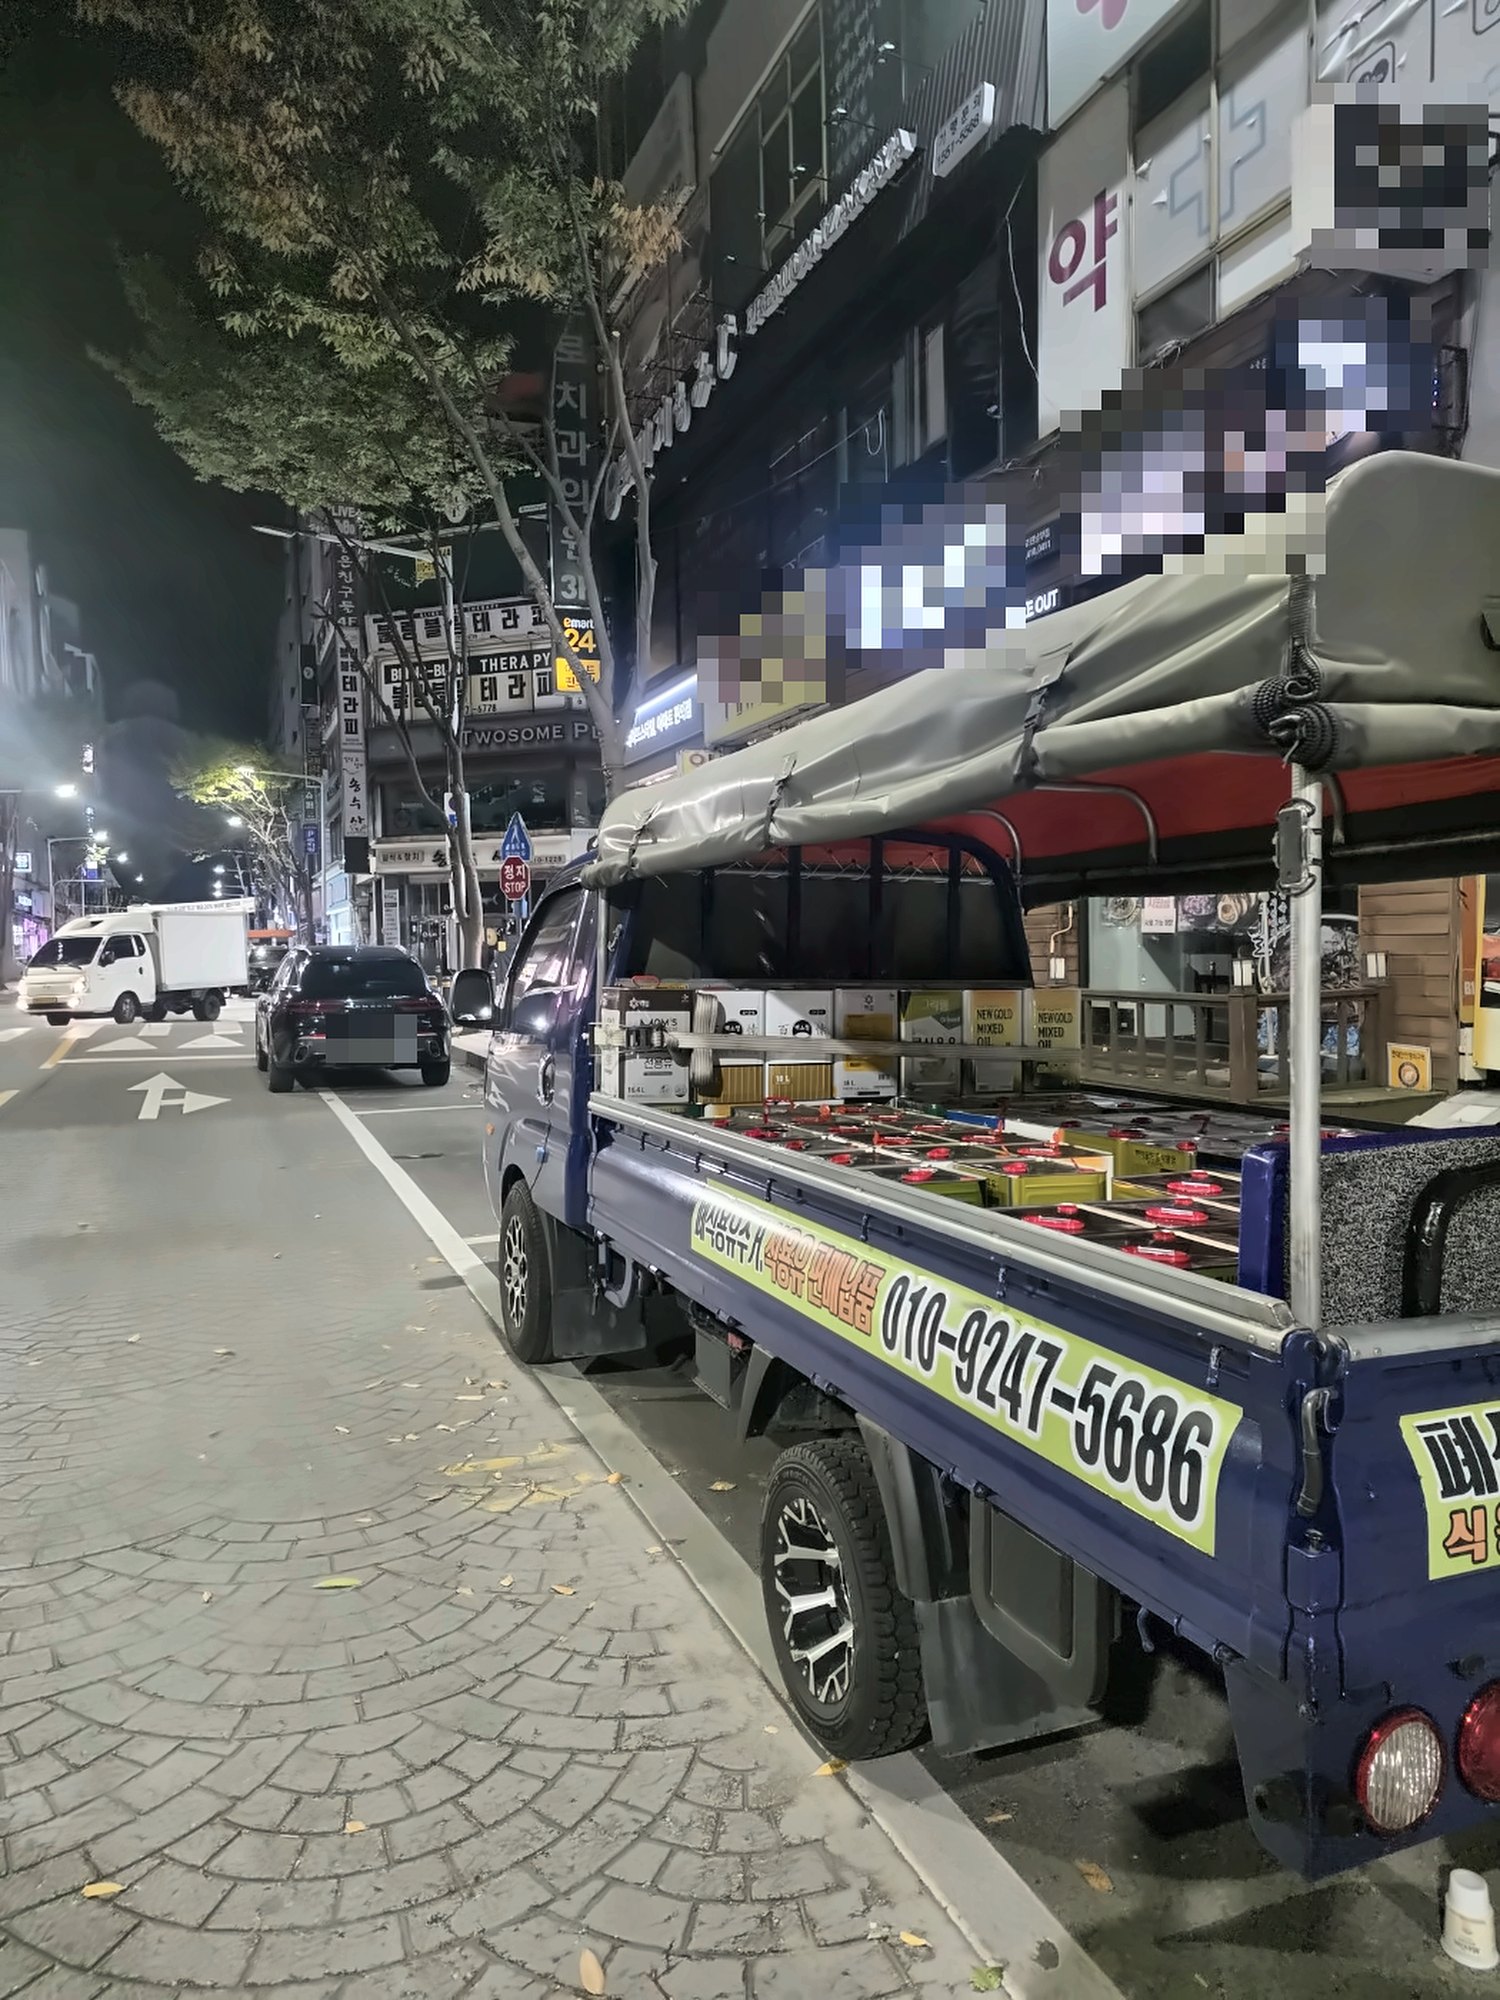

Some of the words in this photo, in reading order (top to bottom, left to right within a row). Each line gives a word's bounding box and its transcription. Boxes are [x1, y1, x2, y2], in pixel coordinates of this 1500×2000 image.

[1048, 187, 1118, 312] 약
[331, 505, 358, 518] LIVE
[1035, 588, 1058, 613] OUT
[337, 616, 358, 626] 4F
[563, 616, 594, 629] emart
[563, 628, 597, 653] 24
[480, 672, 552, 702] 테라피
[342, 675, 359, 735] 테라피
[462, 724, 563, 746] TWOSOME
[574, 722, 602, 740] PL
[504, 863, 526, 880] 정지
[504, 881, 527, 894] STOP
[976, 1009, 994, 1020] NEW
[994, 1008, 1013, 1020] GOLD
[1037, 1012, 1055, 1024] NEW
[1055, 1012, 1073, 1024] GOLD
[976, 1023, 1004, 1035] MIXED
[1037, 1027, 1064, 1038] MIXED
[881, 1274, 1215, 1524] 010-9247-5686
[1414, 1411, 1500, 1500] 폐
[1442, 1502, 1500, 1565] 식
